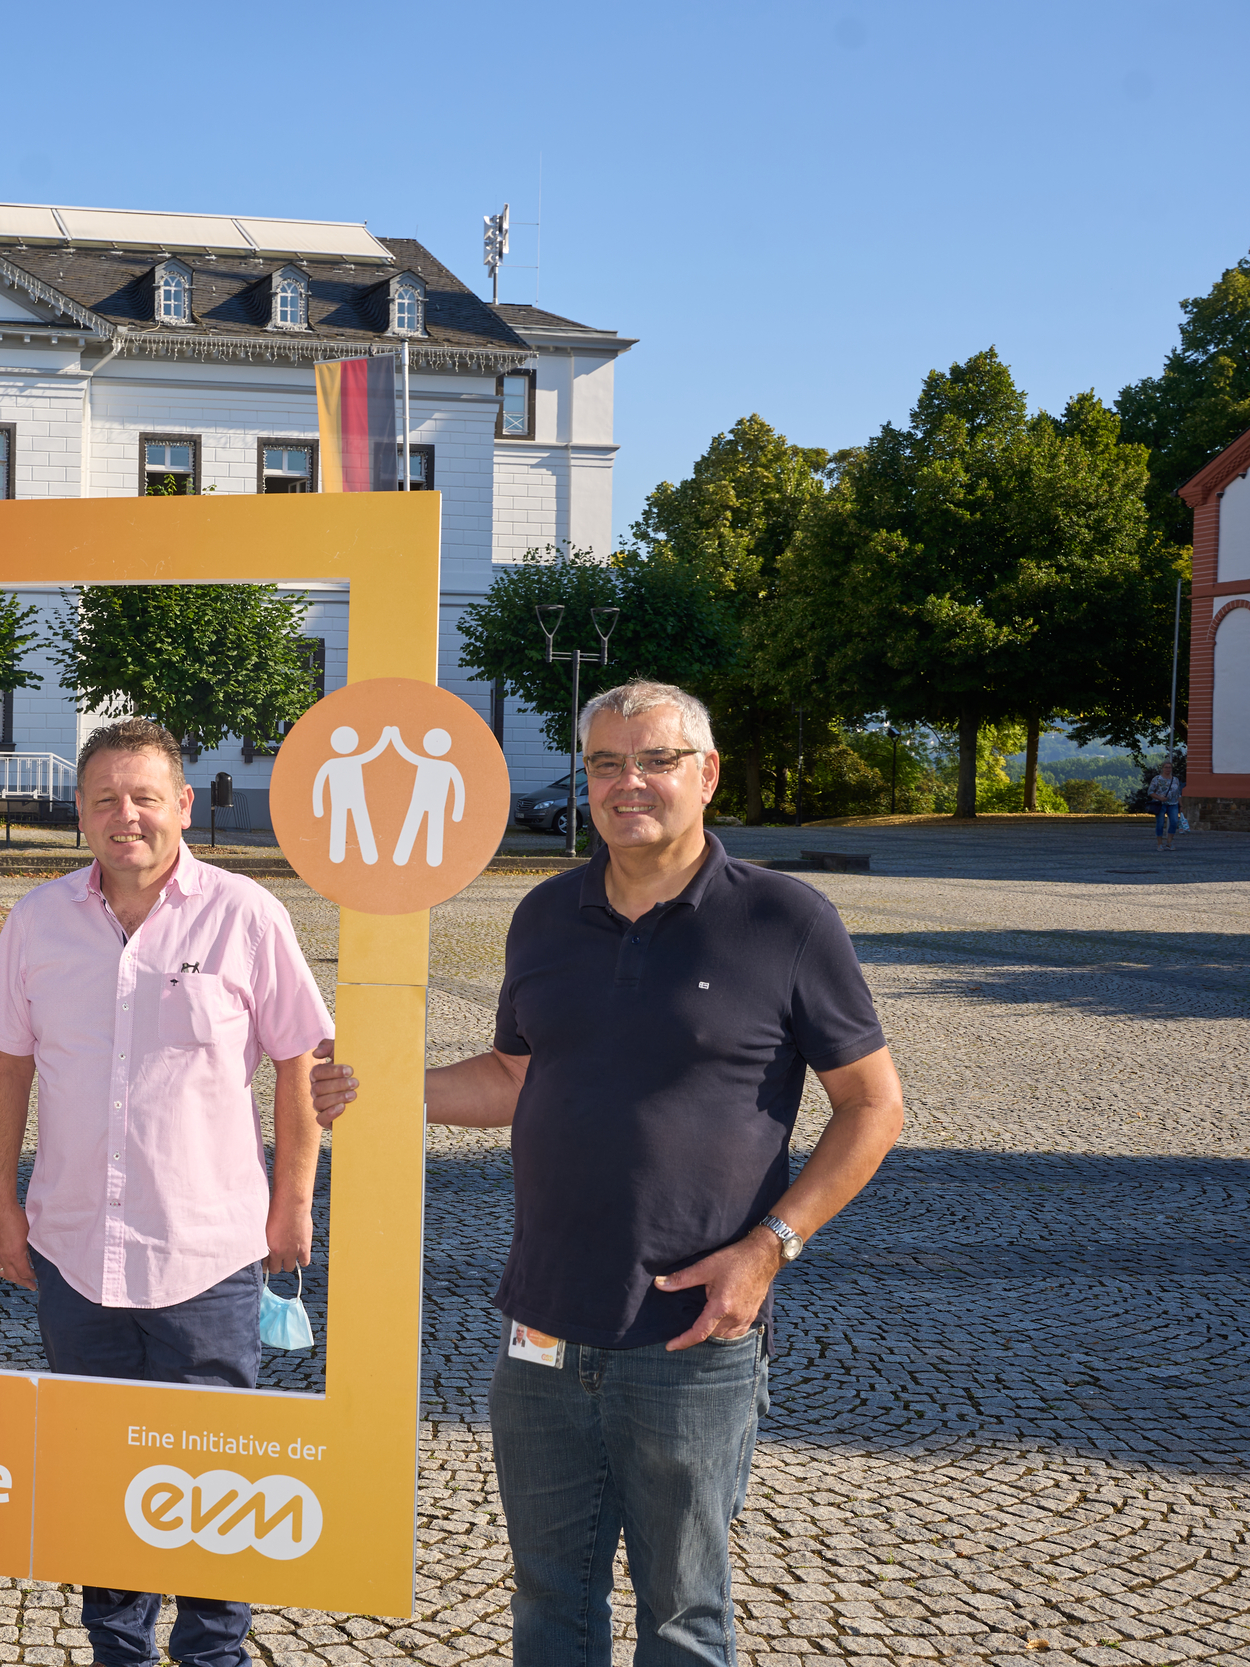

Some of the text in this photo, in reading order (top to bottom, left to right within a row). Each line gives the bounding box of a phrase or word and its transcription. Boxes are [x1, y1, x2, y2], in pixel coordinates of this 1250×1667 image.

[127, 1425, 327, 1461] Eine Initiative der
[140, 1480, 304, 1544] evm
